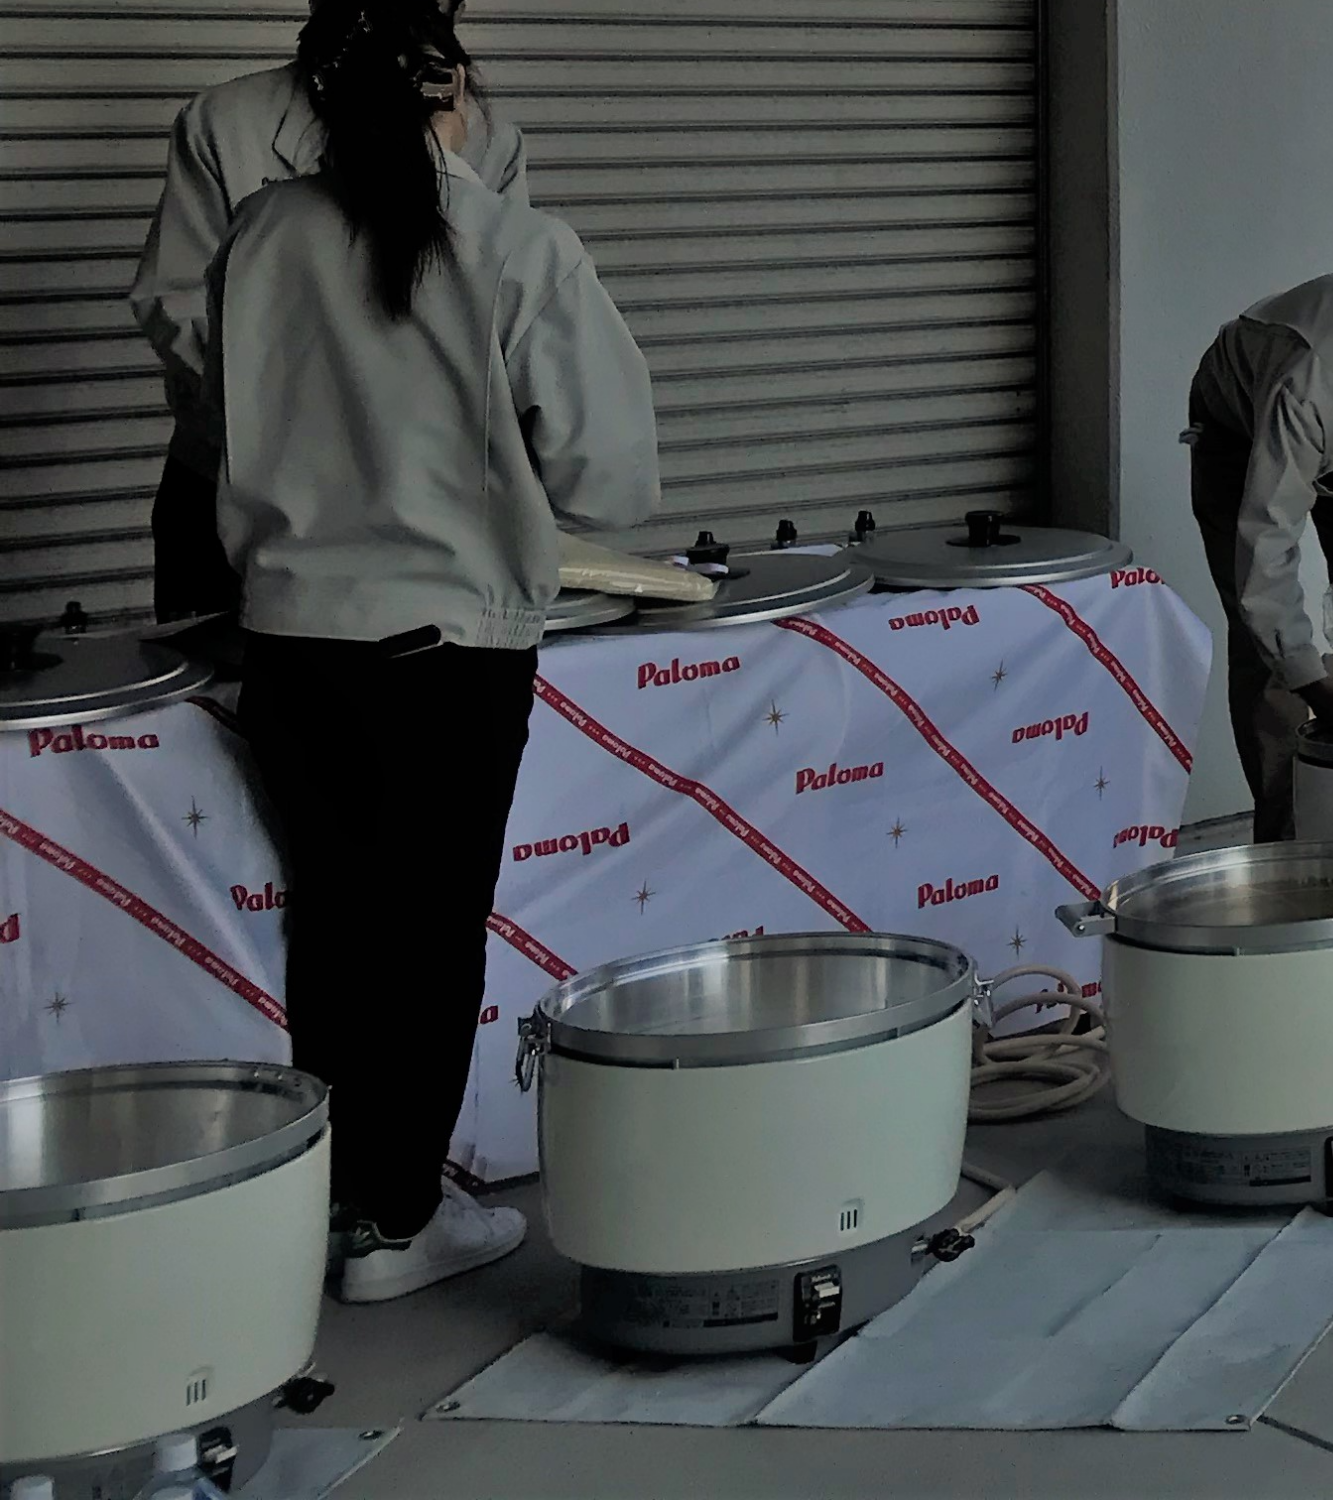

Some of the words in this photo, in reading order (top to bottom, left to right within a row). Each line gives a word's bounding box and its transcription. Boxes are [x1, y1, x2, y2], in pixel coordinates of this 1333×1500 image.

[1110, 567, 1166, 589] Palo
[889, 605, 980, 630] Paloma
[637, 655, 740, 689] Paloma
[27, 724, 160, 758] Paloma
[1012, 712, 1089, 743] Paloma
[795, 762, 884, 794] Paloma
[513, 822, 630, 855] Paloma
[1113, 825, 1180, 848] Palom
[230, 881, 289, 912] Palo
[917, 874, 999, 909] Paloma
